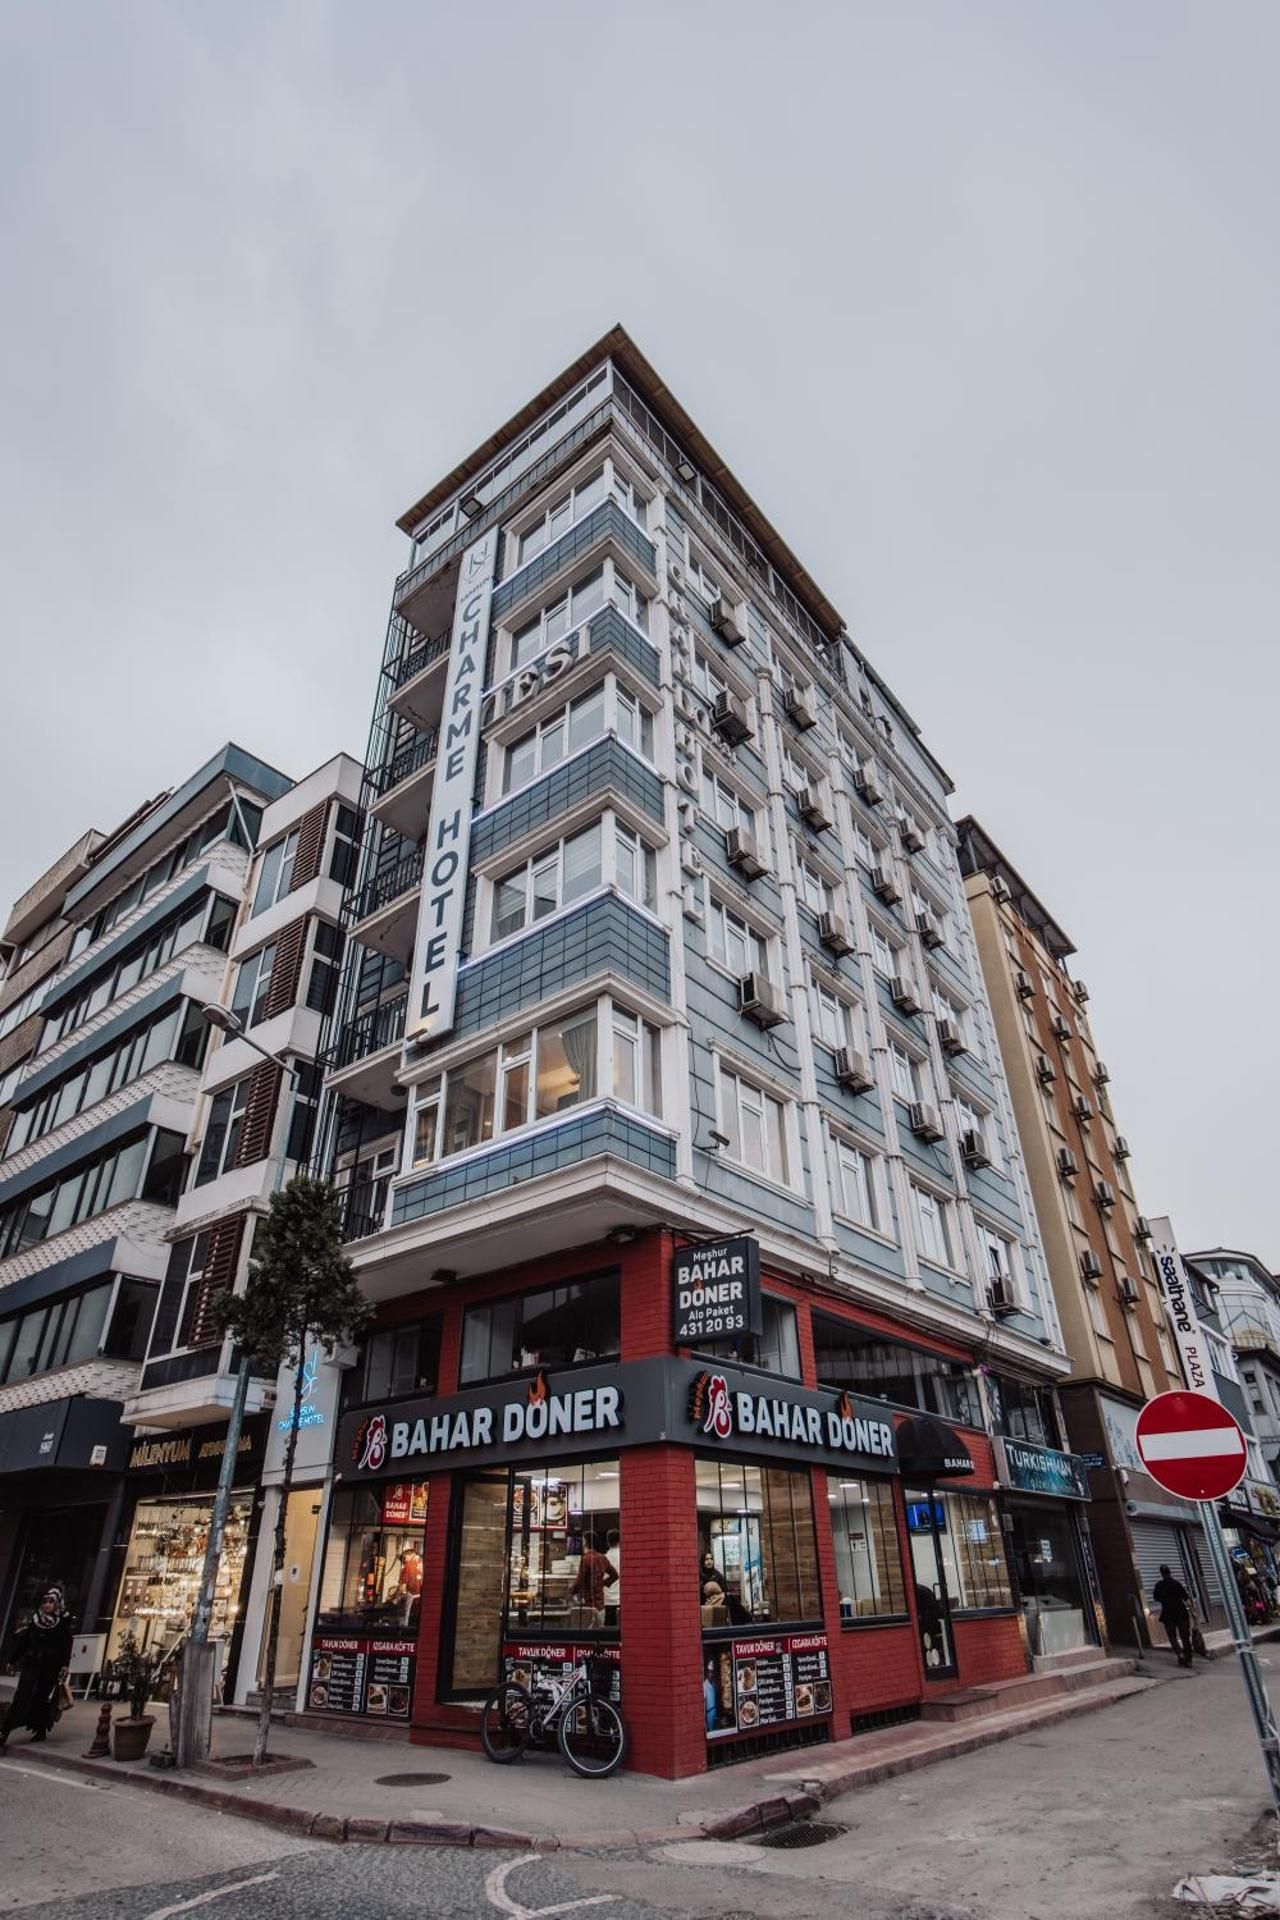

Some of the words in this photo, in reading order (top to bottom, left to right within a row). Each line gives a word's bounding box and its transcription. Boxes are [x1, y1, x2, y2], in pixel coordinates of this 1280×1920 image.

[446, 594, 482, 783] CHARME
[420, 808, 462, 1019] HOTEL
[693, 1248, 728, 1262] Meşhur
[678, 1256, 744, 1285] BAHAR
[680, 1321, 703, 1336] 431
[705, 1318, 723, 1333] 20
[725, 1315, 744, 1329] 93
[688, 1309, 704, 1321] Alo
[706, 1305, 734, 1318] Paket
[1160, 1256, 1192, 1332] saathane
[1185, 1346, 1206, 1388] PLAZA
[390, 1407, 493, 1458] BAHAR
[736, 1392, 823, 1445] BAHAR
[518, 1647, 541, 1657] TAVUK
[541, 1646, 566, 1659] DÖNER
[755, 1640, 775, 1654] DÖNER
